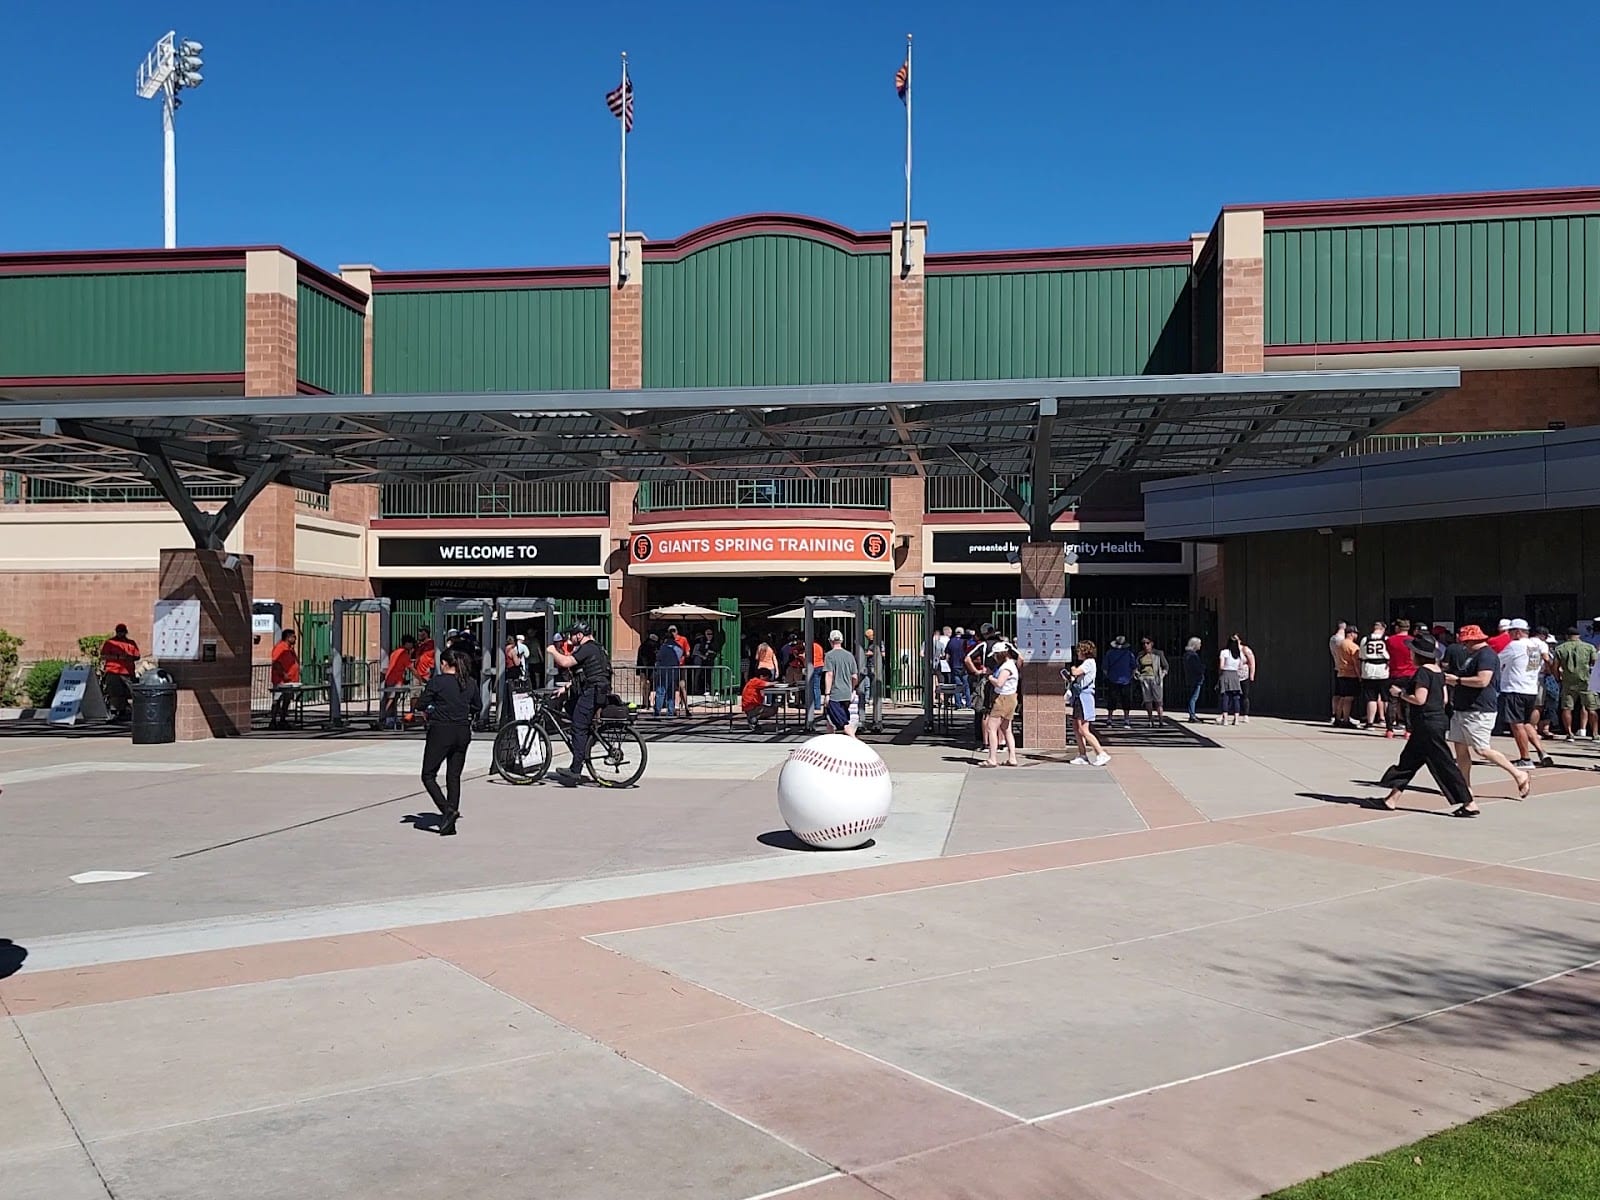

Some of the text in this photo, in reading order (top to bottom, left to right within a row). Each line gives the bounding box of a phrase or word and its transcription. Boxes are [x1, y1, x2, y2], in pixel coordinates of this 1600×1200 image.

[440, 545, 538, 559] WELCOME TO
[659, 537, 855, 554] GIANTS SPRING TRAINING
[969, 541, 1020, 554] presented by
[1063, 541, 1098, 556] ignity
[1366, 643, 1384, 655] 62
